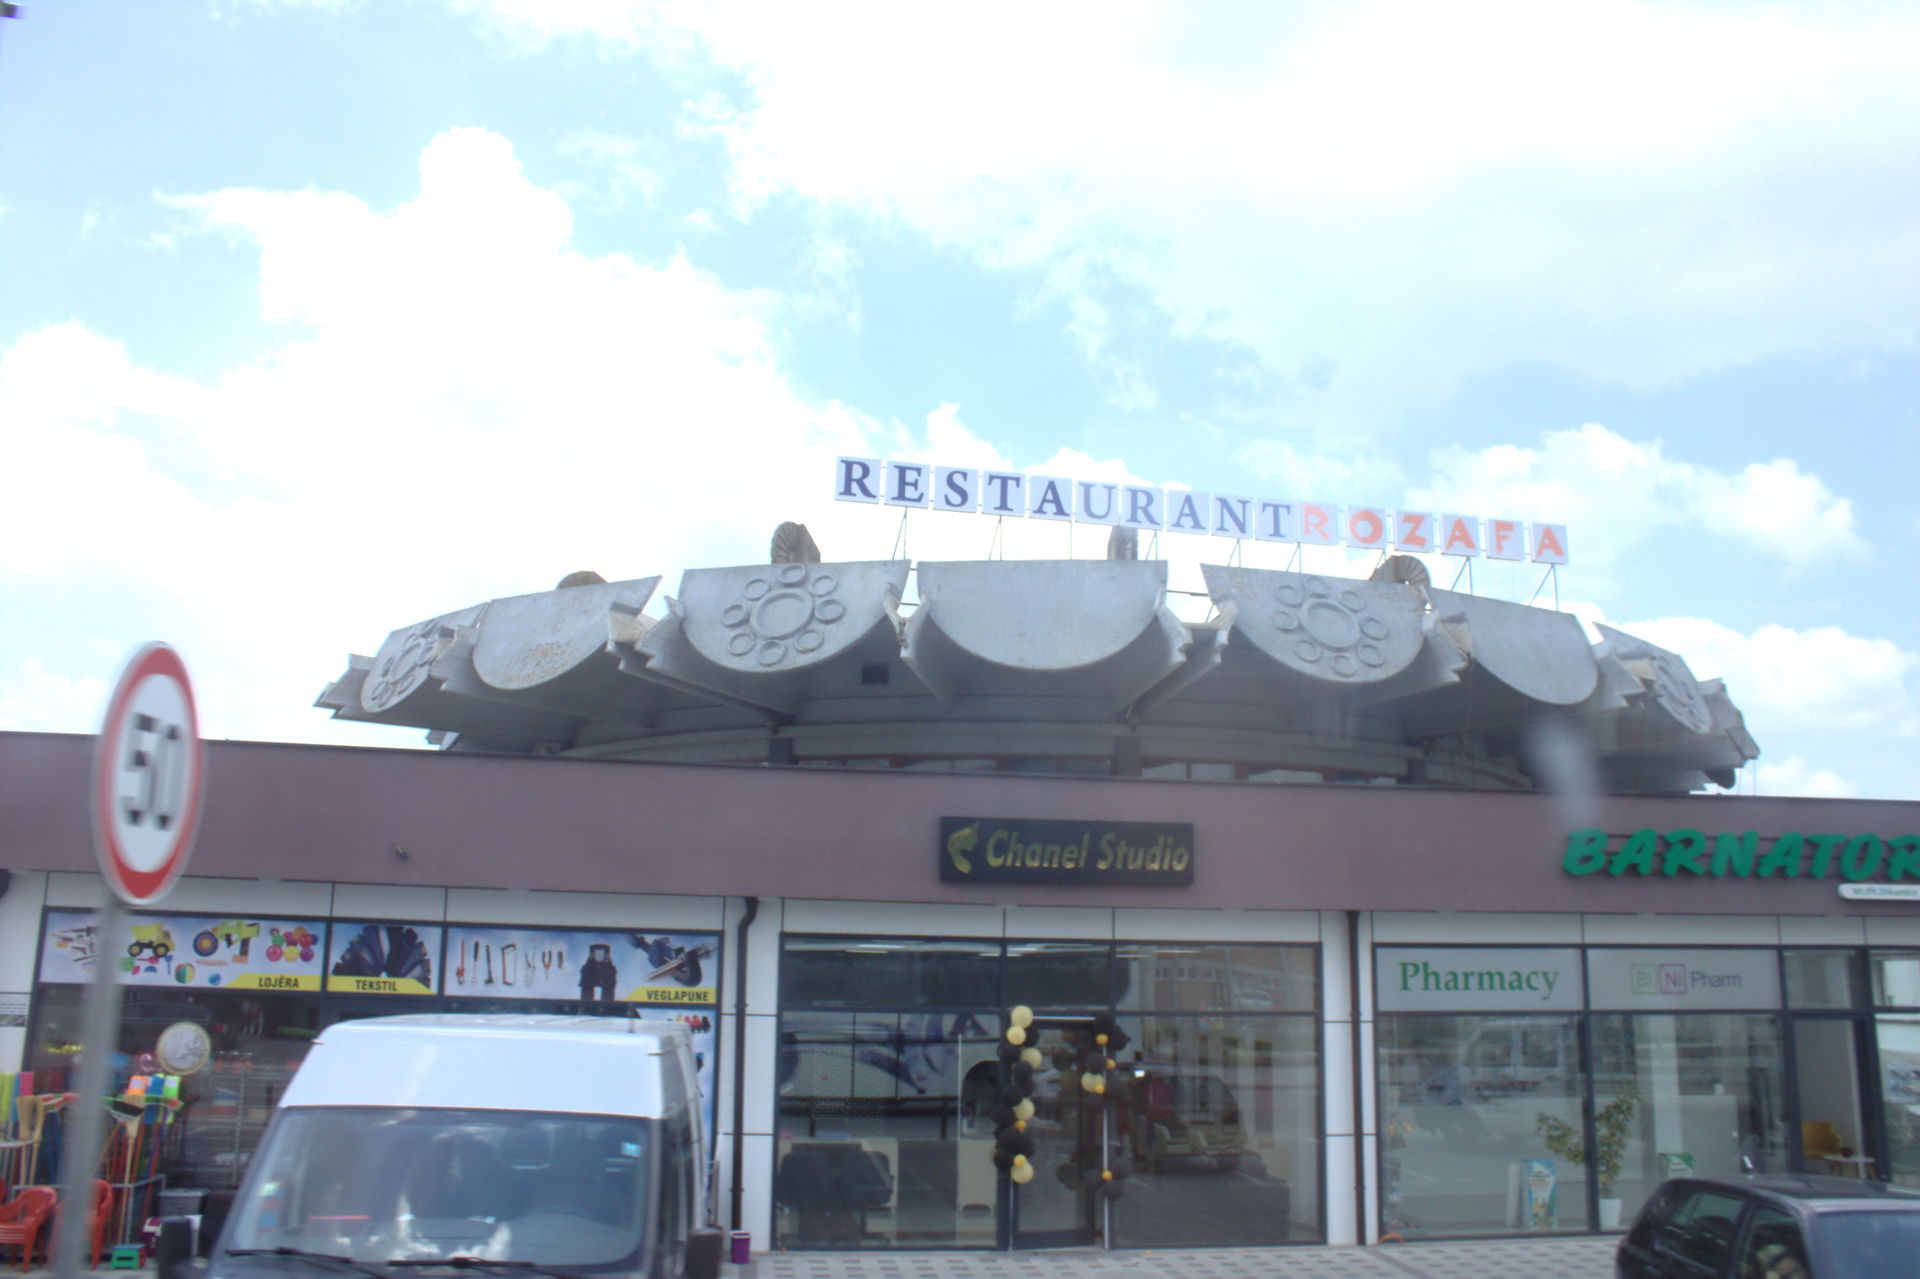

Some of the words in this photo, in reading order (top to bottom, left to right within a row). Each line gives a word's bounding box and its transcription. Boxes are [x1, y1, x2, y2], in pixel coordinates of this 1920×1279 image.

[838, 458, 1292, 540] RESTAURANT
[1303, 504, 1566, 560] ROZAFA
[985, 829, 1091, 870] Chanel
[1097, 832, 1190, 872] Studio
[1561, 828, 1920, 881] BARNATOR
[355, 979, 398, 992] TEKSTIL
[646, 989, 709, 1002] VEGLAPUNE
[1398, 960, 1560, 1001] Pharmacy
[1690, 970, 1742, 988] Pharm
